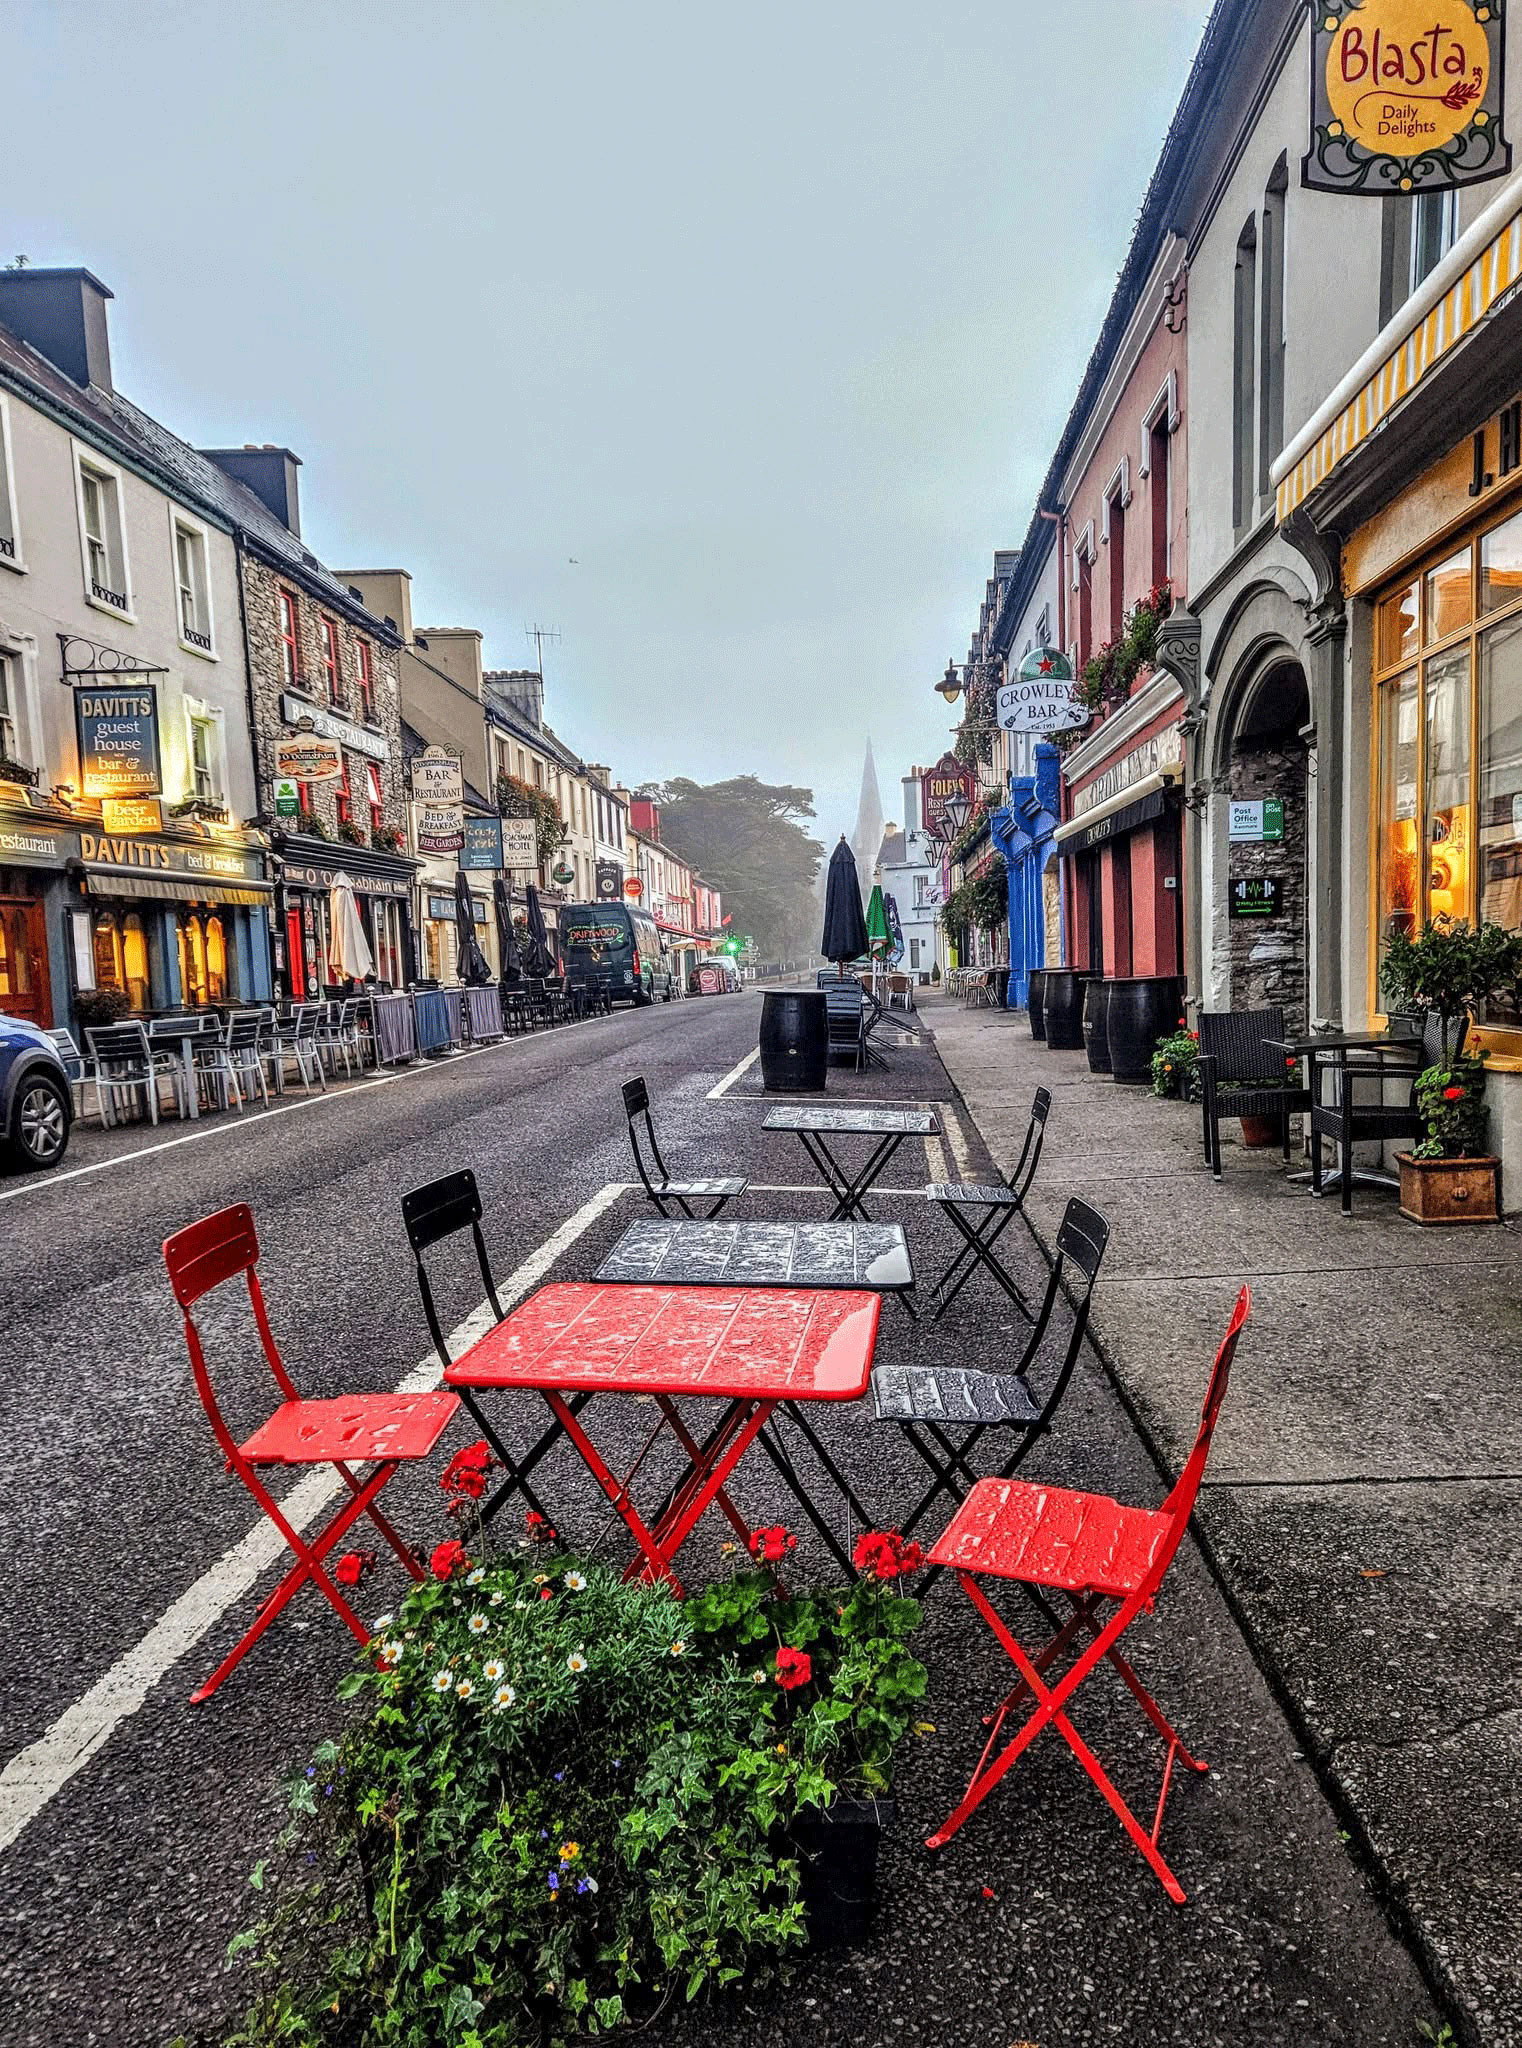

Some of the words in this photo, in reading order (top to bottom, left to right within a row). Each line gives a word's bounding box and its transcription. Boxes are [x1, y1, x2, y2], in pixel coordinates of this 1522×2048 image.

[1341, 24, 1466, 86] Blasta
[1383, 104, 1418, 121] Daily
[1378, 121, 1436, 137] Delights
[81, 697, 152, 718] DAVITTS
[1028, 704, 1057, 719] BAR
[96, 721, 140, 738] guest
[94, 736, 141, 751] house
[98, 757, 122, 770] bar
[125, 758, 139, 769] &
[85, 771, 154, 783] restaurant
[425, 770, 452, 780] BAR
[415, 787, 461, 799] RESTAURANT
[114, 804, 145, 815] beer
[425, 811, 444, 822] BED
[446, 811, 456, 821] &
[1234, 815, 1258, 823] Office
[419, 820, 462, 831] BREAKFAST
[0, 832, 57, 854] estaurant
[436, 835, 463, 848] GARDEN
[508, 842, 531, 851] HOTEL
[187, 851, 203, 869] bed
[571, 928, 619, 939] DRIFTWOOD
